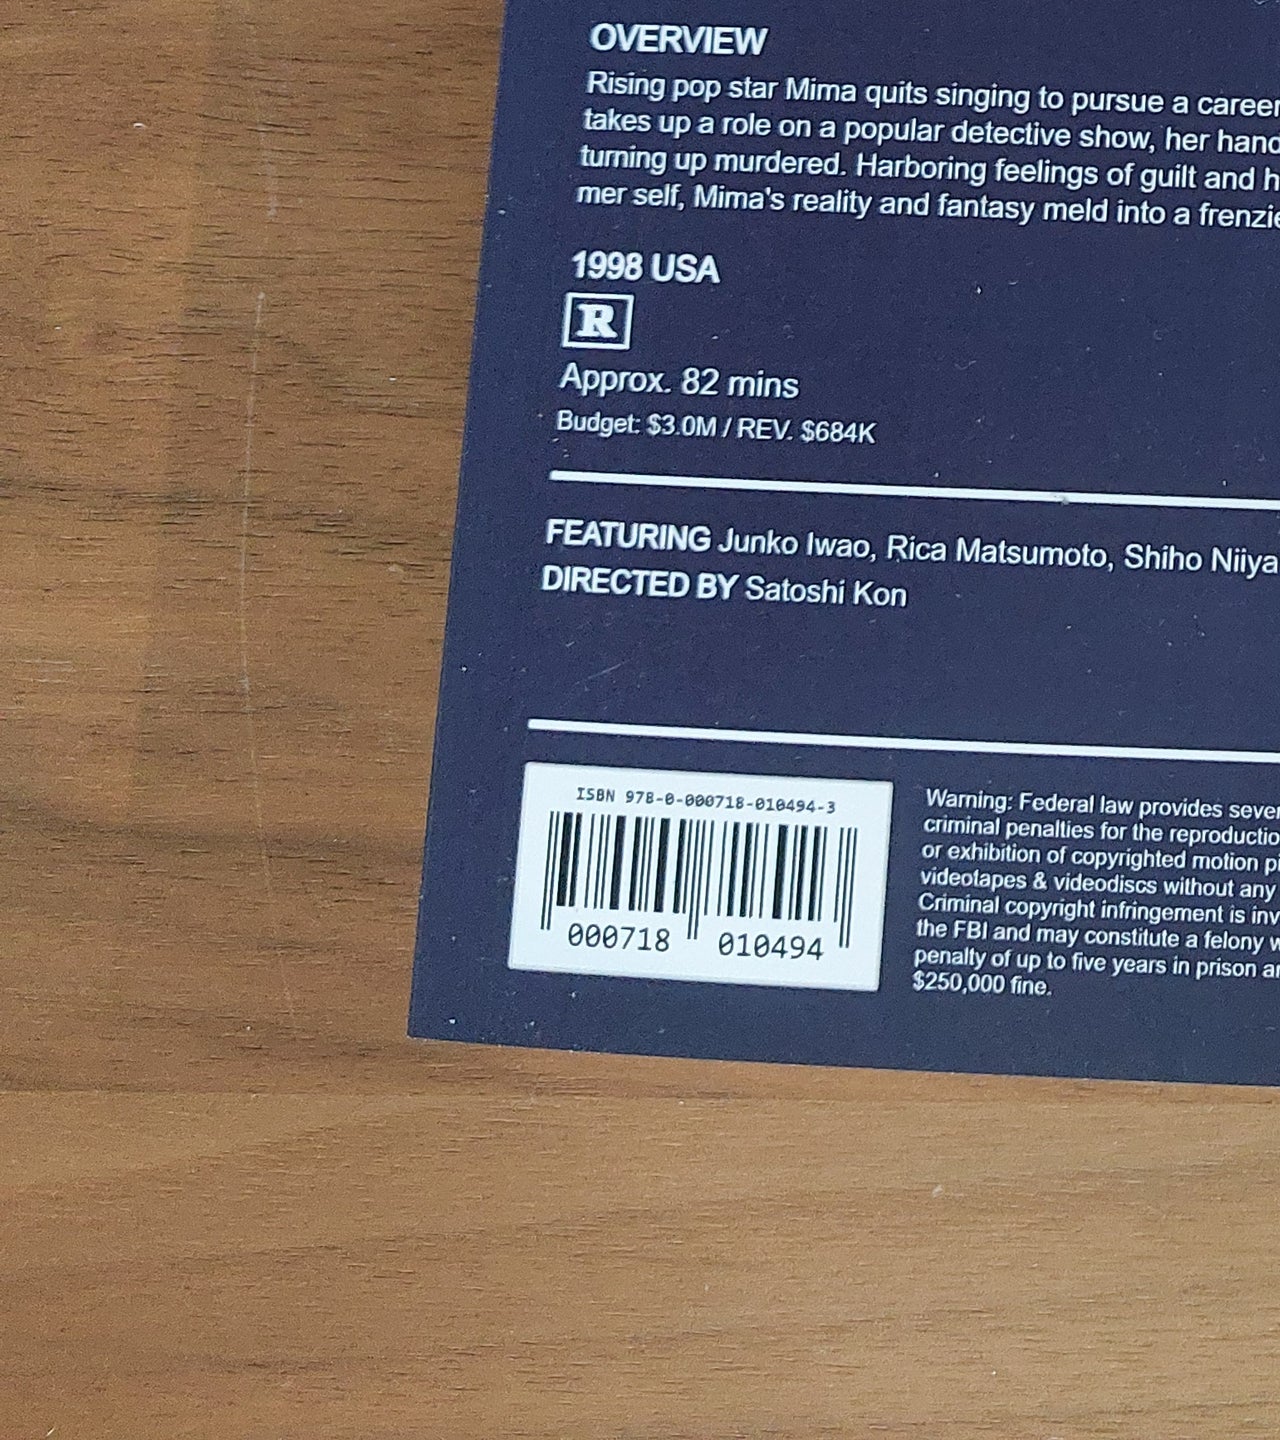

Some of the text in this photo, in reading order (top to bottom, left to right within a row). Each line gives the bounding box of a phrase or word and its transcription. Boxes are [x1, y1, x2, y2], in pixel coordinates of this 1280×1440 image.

[589, 21, 768, 56] OVERVIEW
[586, 70, 665, 102] Rising
[671, 78, 722, 103] pop
[727, 75, 779, 99] star
[785, 75, 856, 102] Mima
[864, 79, 928, 108] quits
[934, 81, 1030, 114] singing
[1037, 85, 1064, 109] to
[1071, 91, 1164, 116] pursue
[1171, 95, 1189, 113] a
[583, 107, 651, 132] takes
[658, 114, 692, 139] up
[696, 115, 714, 134] a
[721, 112, 771, 135] role
[777, 118, 811, 137] on
[818, 119, 836, 138] a
[843, 116, 945, 146] popular
[950, 119, 1071, 147] detective
[1078, 123, 1154, 154] show,
[1164, 125, 1211, 151] her
[579, 143, 667, 176] turning
[673, 151, 707, 177] up
[713, 148, 846, 176] murdered.
[855, 151, 987, 186] Harboring
[994, 157, 1099, 190] feelings
[1105, 161, 1135, 186] of
[1139, 163, 1197, 193] guilt
[1203, 165, 1255, 190] and
[575, 185, 628, 204] mer
[631, 182, 684, 211] self,
[693, 183, 785, 210] Mima's
[792, 188, 872, 219] reality
[878, 191, 929, 216] and
[937, 191, 1035, 225] fantasy
[1042, 196, 1108, 222] meld
[1116, 198, 1166, 224] into
[1172, 206, 1190, 225] a
[571, 249, 720, 283] 1998 USA
[575, 303, 618, 338] R
[558, 361, 799, 399] Approx. 82 mins
[556, 408, 876, 444] Budget: $3.0M / REV. $684K
[545, 517, 711, 552] FEATURING
[717, 526, 799, 555] Junko
[806, 530, 876, 562] Iwao,
[886, 533, 947, 561] Rica
[955, 536, 1113, 572] Matsumoto,
[1123, 543, 1203, 570] Shiho
[540, 563, 907, 607] DIRECTED BY Satoshi Kon
[575, 786, 835, 814] ISBN 978-0-000718-010494-3
[925, 787, 1013, 813] Warning:
[1018, 791, 1094, 814] Federal
[1099, 794, 1134, 815] law
[1138, 797, 1223, 819] provides
[922, 814, 1000, 835] criminal
[1004, 818, 1095, 839] penalties
[1099, 821, 1128, 840] for
[1131, 822, 1164, 842] the
[920, 843, 943, 858] or
[946, 841, 1041, 863] exhibition
[1045, 845, 1067, 864] of
[1070, 847, 1186, 872] copyrighted
[1191, 851, 1259, 871] motion
[920, 865, 1027, 892] videotapes
[1031, 871, 1047, 890] &
[1053, 872, 1157, 894] videodiscs
[1162, 875, 1234, 897] without
[1238, 883, 1276, 903] any
[917, 891, 1000, 914] Criminal
[1003, 897, 1095, 921] copyright
[1100, 898, 1223, 924] infringement
[1228, 908, 1246, 923] is
[567, 922, 823, 961] 000718 010494
[911, 969, 1051, 995] $250,000 fine.
